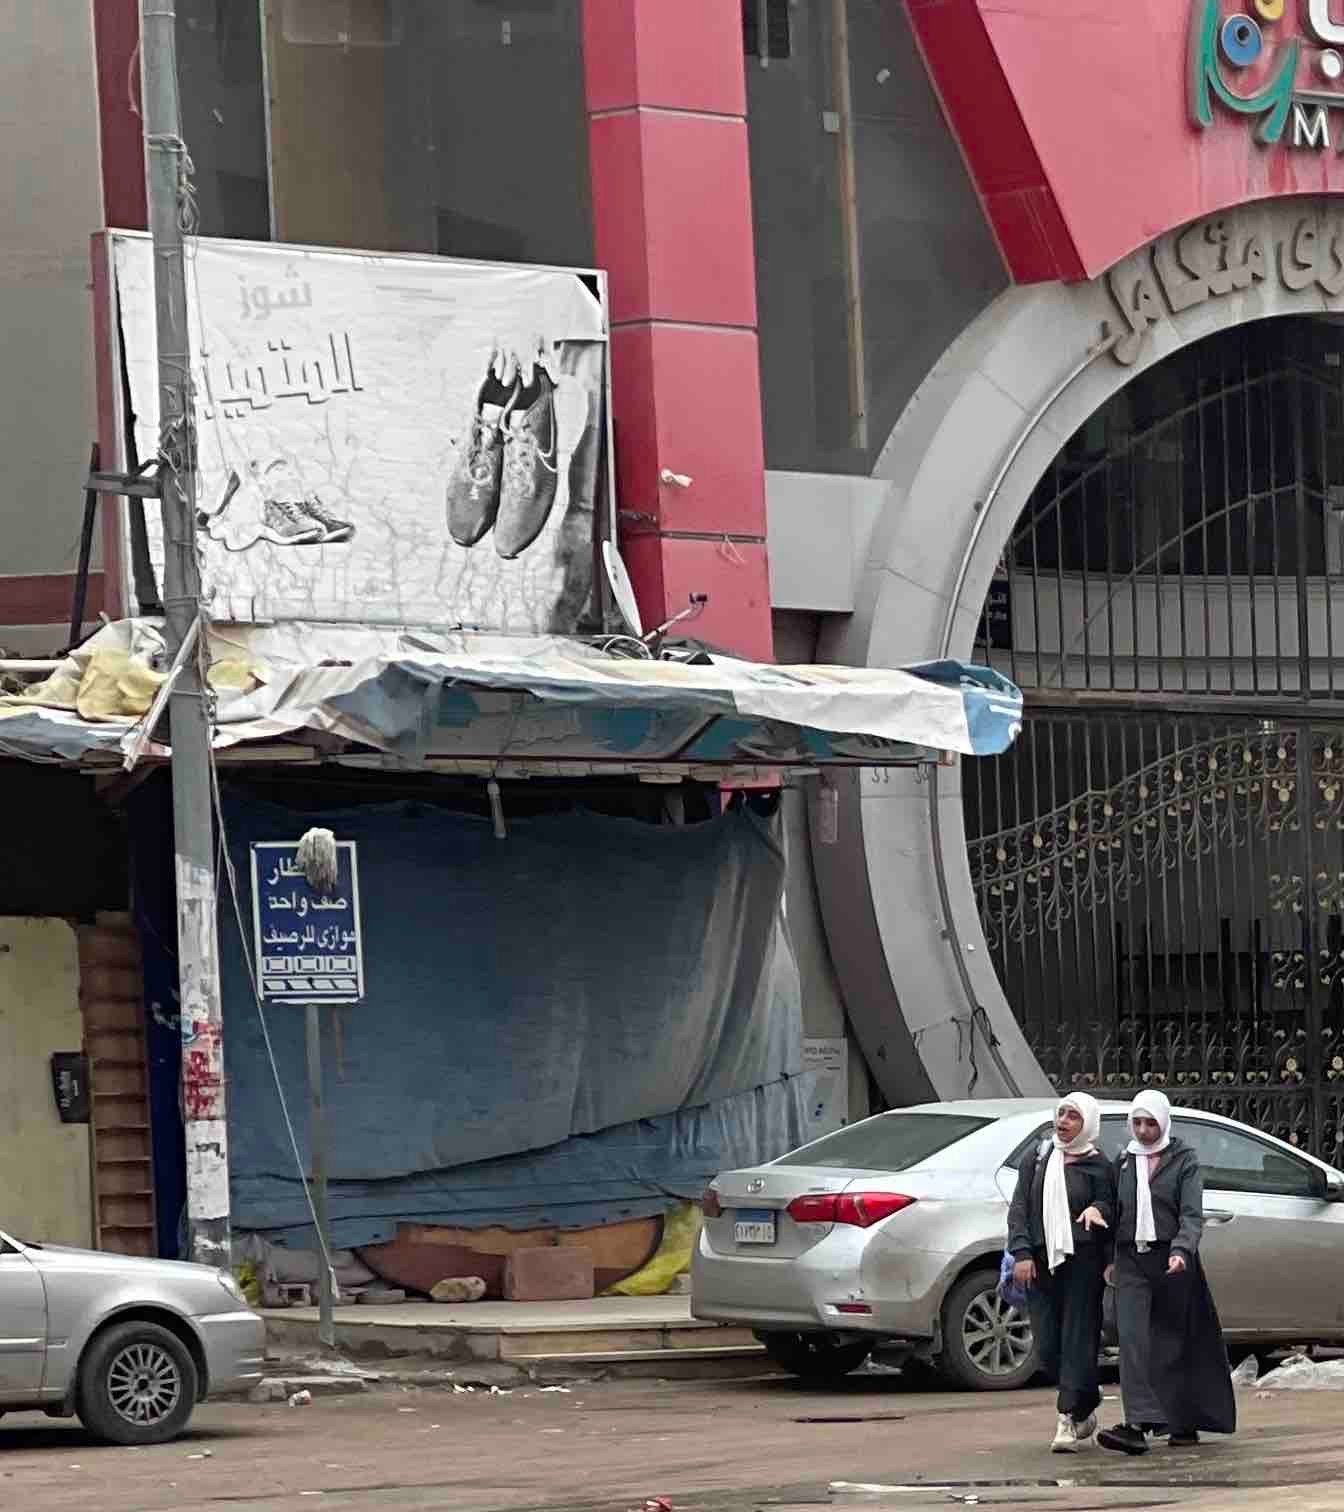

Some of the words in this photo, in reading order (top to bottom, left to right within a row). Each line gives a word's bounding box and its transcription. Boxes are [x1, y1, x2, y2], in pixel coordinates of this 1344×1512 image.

[268, 891, 309, 918] واحد
[310, 895, 348, 910] صف
[263, 923, 315, 952] للرصيف
